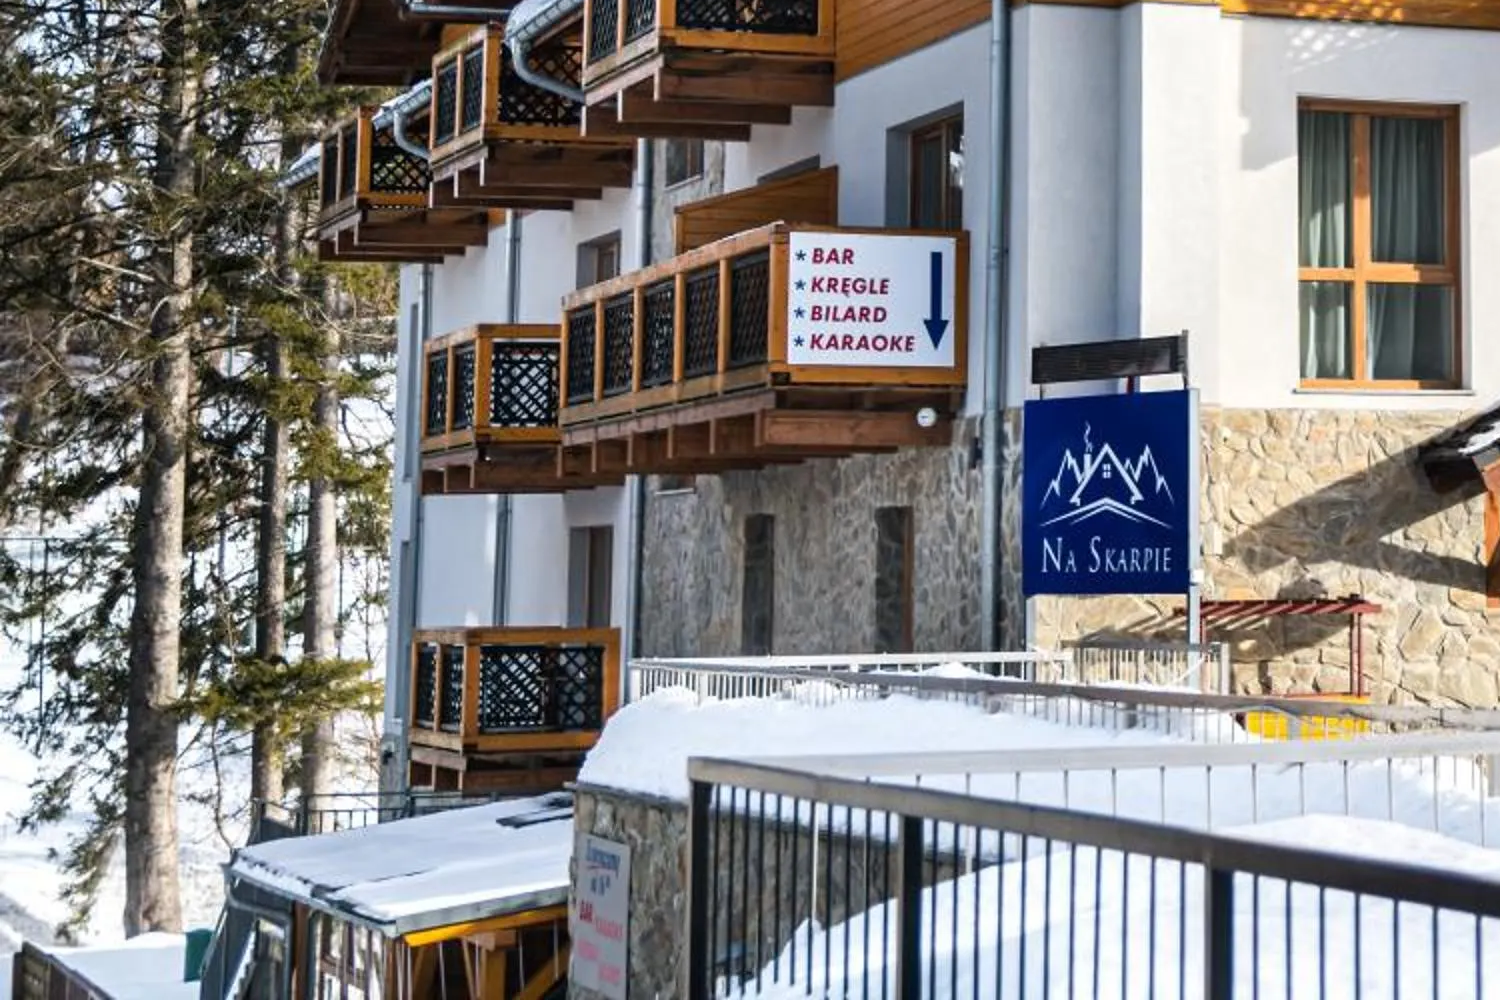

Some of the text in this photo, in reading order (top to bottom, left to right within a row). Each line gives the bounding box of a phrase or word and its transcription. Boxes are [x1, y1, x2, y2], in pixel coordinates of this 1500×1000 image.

[812, 248, 854, 264] BAR
[811, 277, 890, 297] KRĘGLE
[810, 305, 887, 323] BILARD
[809, 334, 915, 352] KARAOKE
[1041, 535, 1172, 573] NA SKARPIE
